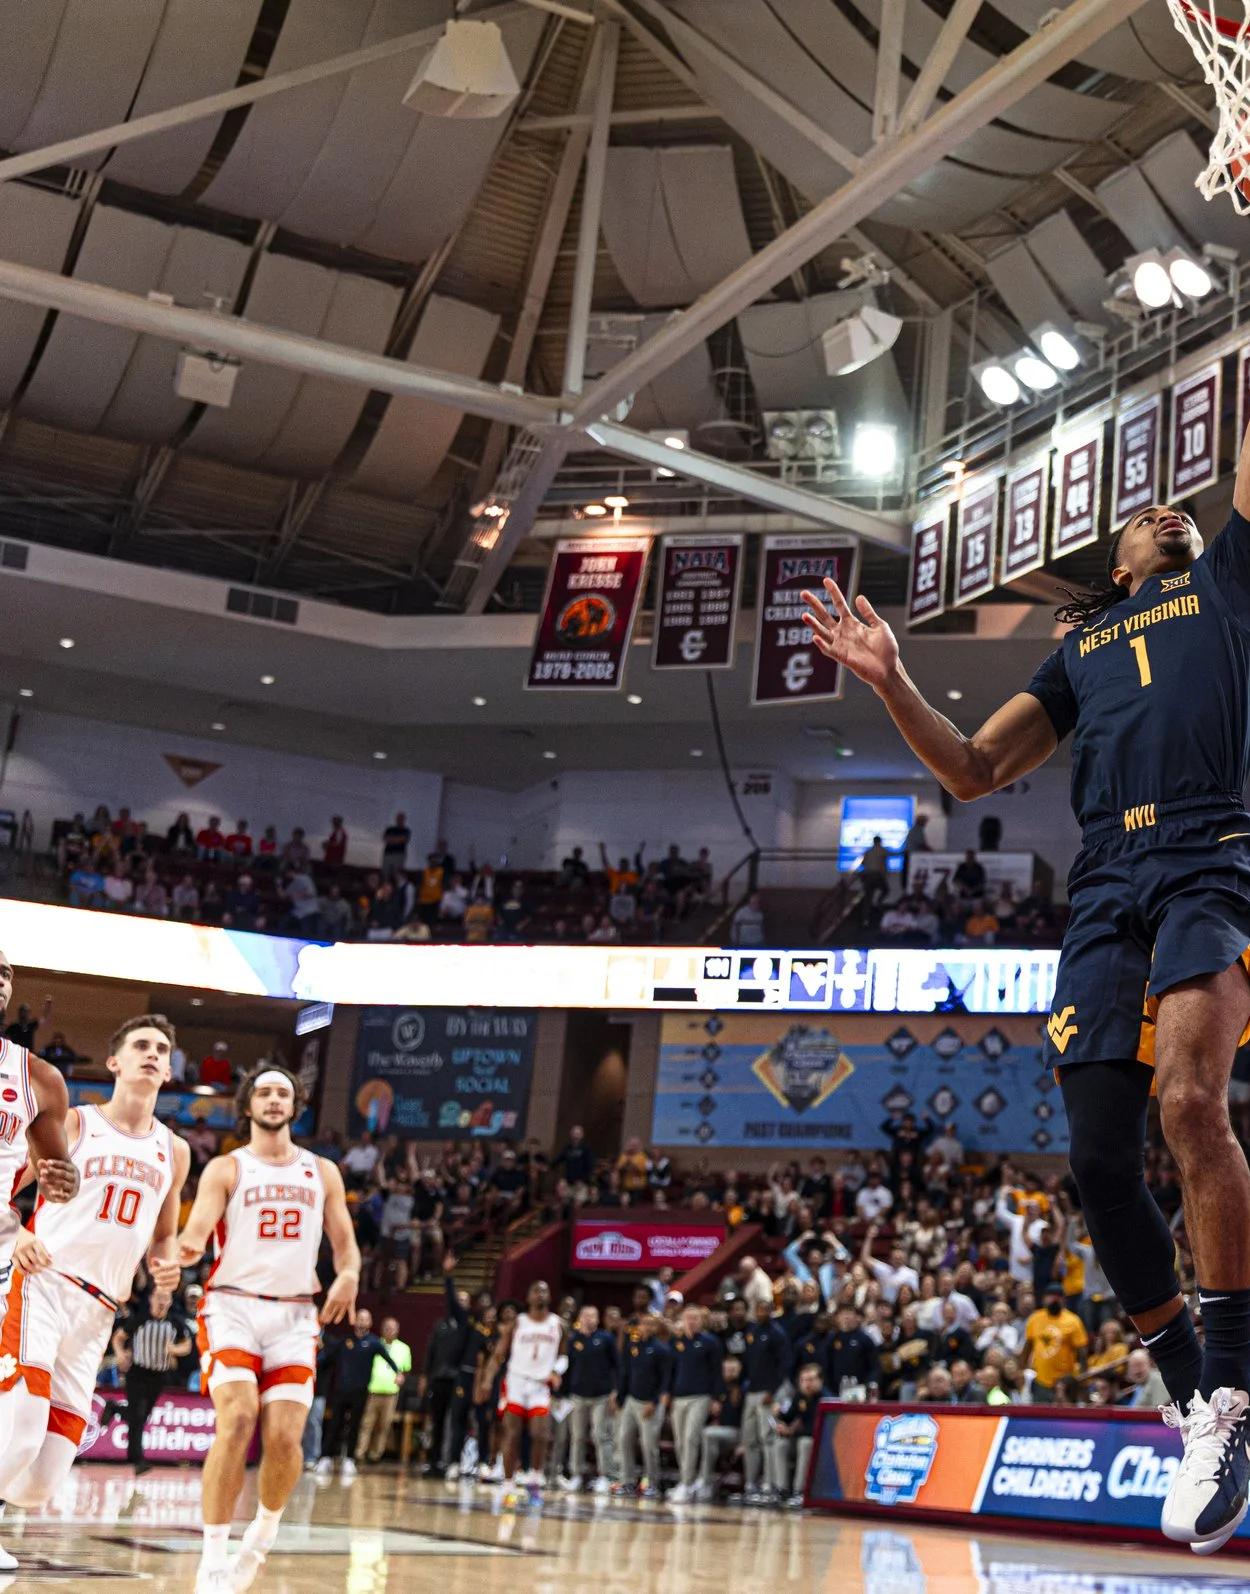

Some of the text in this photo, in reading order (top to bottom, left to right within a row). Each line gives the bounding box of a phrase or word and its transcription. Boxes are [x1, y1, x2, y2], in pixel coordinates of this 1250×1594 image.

[1182, 421, 1206, 463] 10
[1124, 450, 1148, 490] 55
[1065, 480, 1090, 519] 44
[1014, 507, 1035, 546] 13
[669, 549, 731, 577] NAIA
[965, 532, 986, 570] 15
[566, 572, 624, 590] KRESSE
[776, 555, 839, 585] NAIA
[916, 557, 937, 593] 22
[775, 627, 814, 647] 198
[1079, 594, 1200, 658] WEST VIRGINIA
[534, 661, 616, 681] 1979-2002
[1129, 634, 1153, 688] 1
[1123, 803, 1157, 832] WVU
[451, 1046, 521, 1066] UPTOWN
[83, 1154, 165, 1197] CLEMSON
[95, 1181, 145, 1230] 10
[243, 1183, 316, 1210] CLEMSON
[257, 1207, 304, 1242] 22
[1001, 1435, 1096, 1469] SHRINERS
[992, 1465, 1103, 1503] CHILDREN'S
